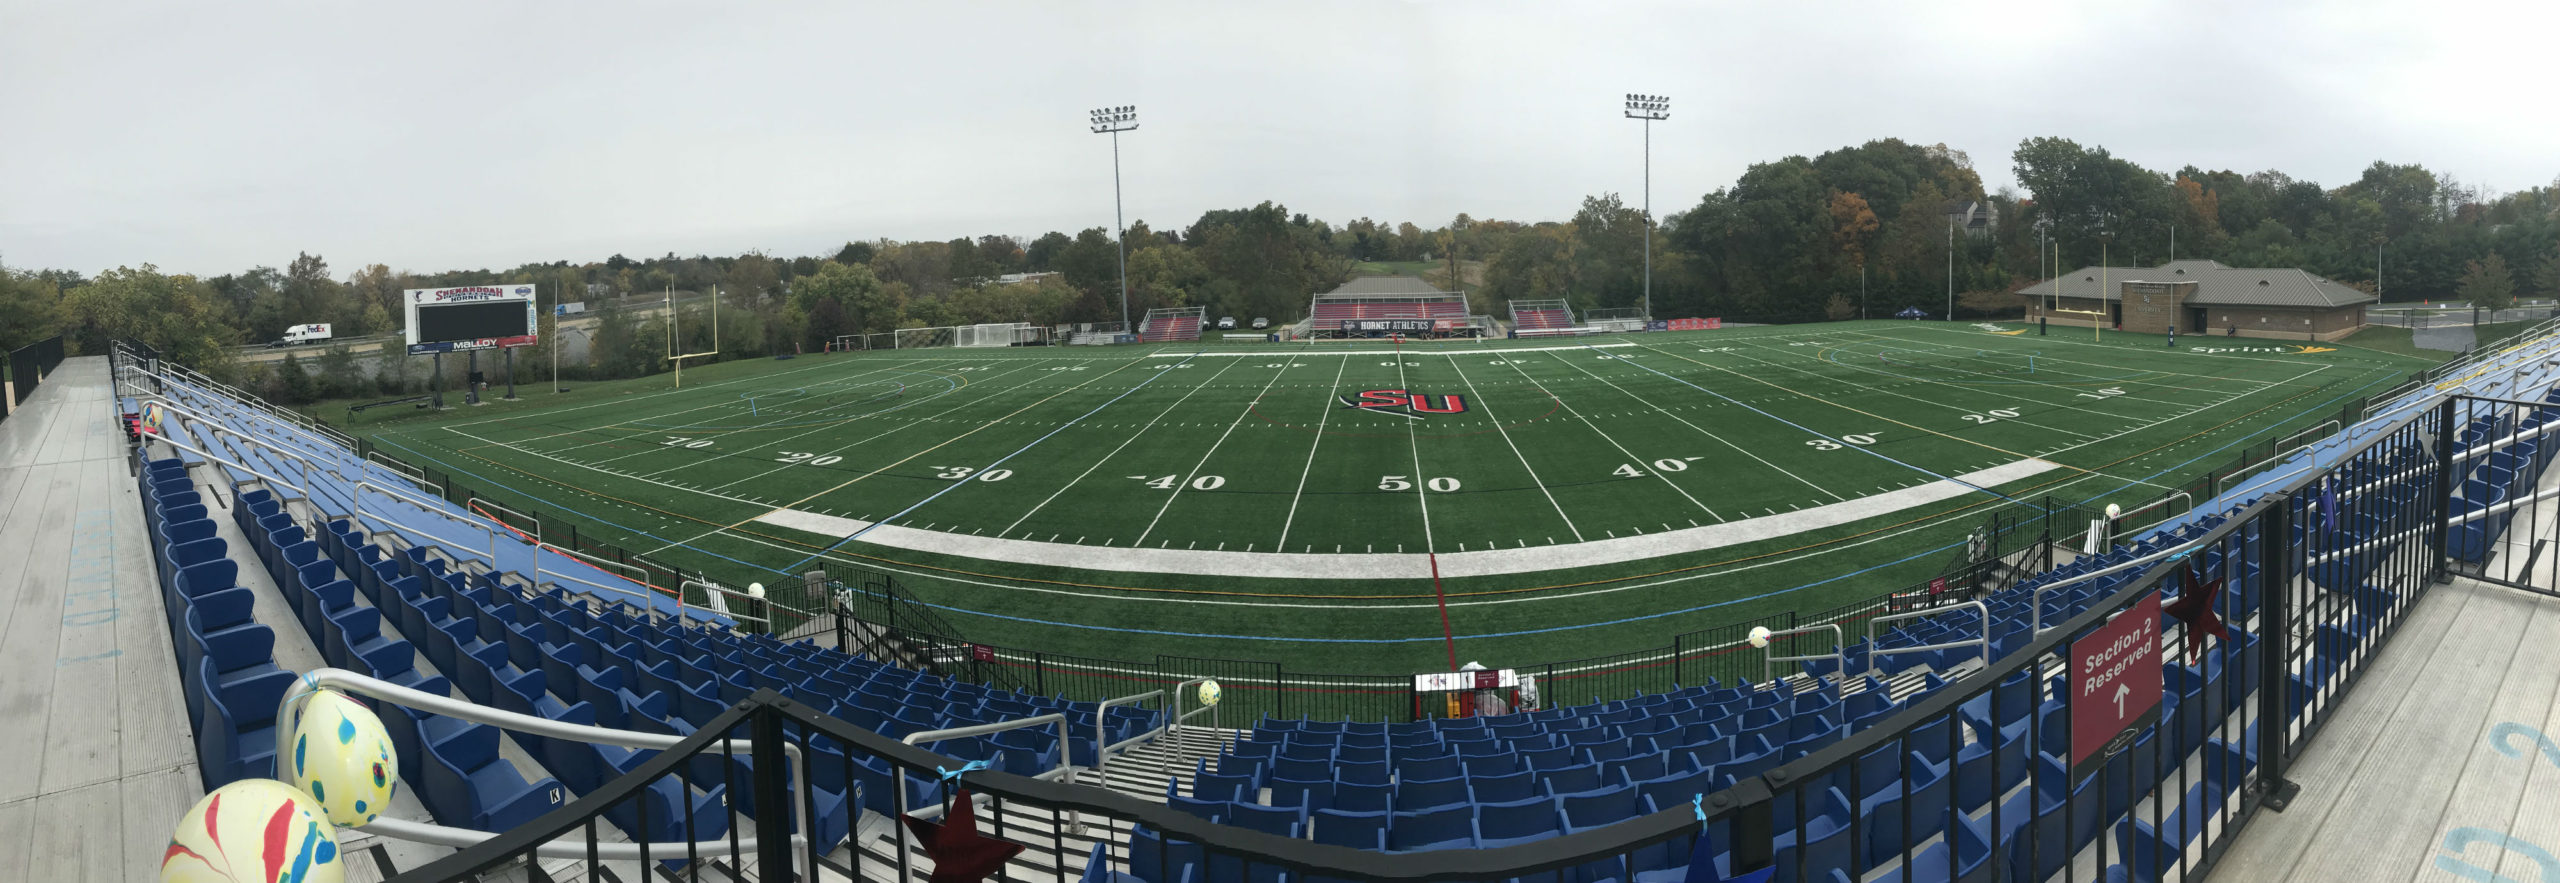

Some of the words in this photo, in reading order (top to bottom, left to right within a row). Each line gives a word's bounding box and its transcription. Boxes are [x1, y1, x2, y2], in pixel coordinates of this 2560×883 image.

[435, 287, 503, 301] SHENANDOAH
[307, 325, 325, 333] FedEx
[1361, 321, 1390, 330] HORNET
[1354, 389, 1469, 414] SU
[2075, 387, 2127, 400] 10
[1961, 408, 2021, 424] 20
[660, 436, 714, 449] 10
[1805, 434, 1877, 451] 30
[774, 452, 843, 466] 20
[937, 466, 1013, 482] 30
[1612, 458, 1688, 478] 40
[1145, 474, 1226, 490] 40
[1378, 475, 1461, 492] 50
[2084, 627, 2141, 674] Section
[2144, 616, 2152, 633] 2
[2084, 636, 2153, 697] Reserved
[551, 789, 559, 803] K
